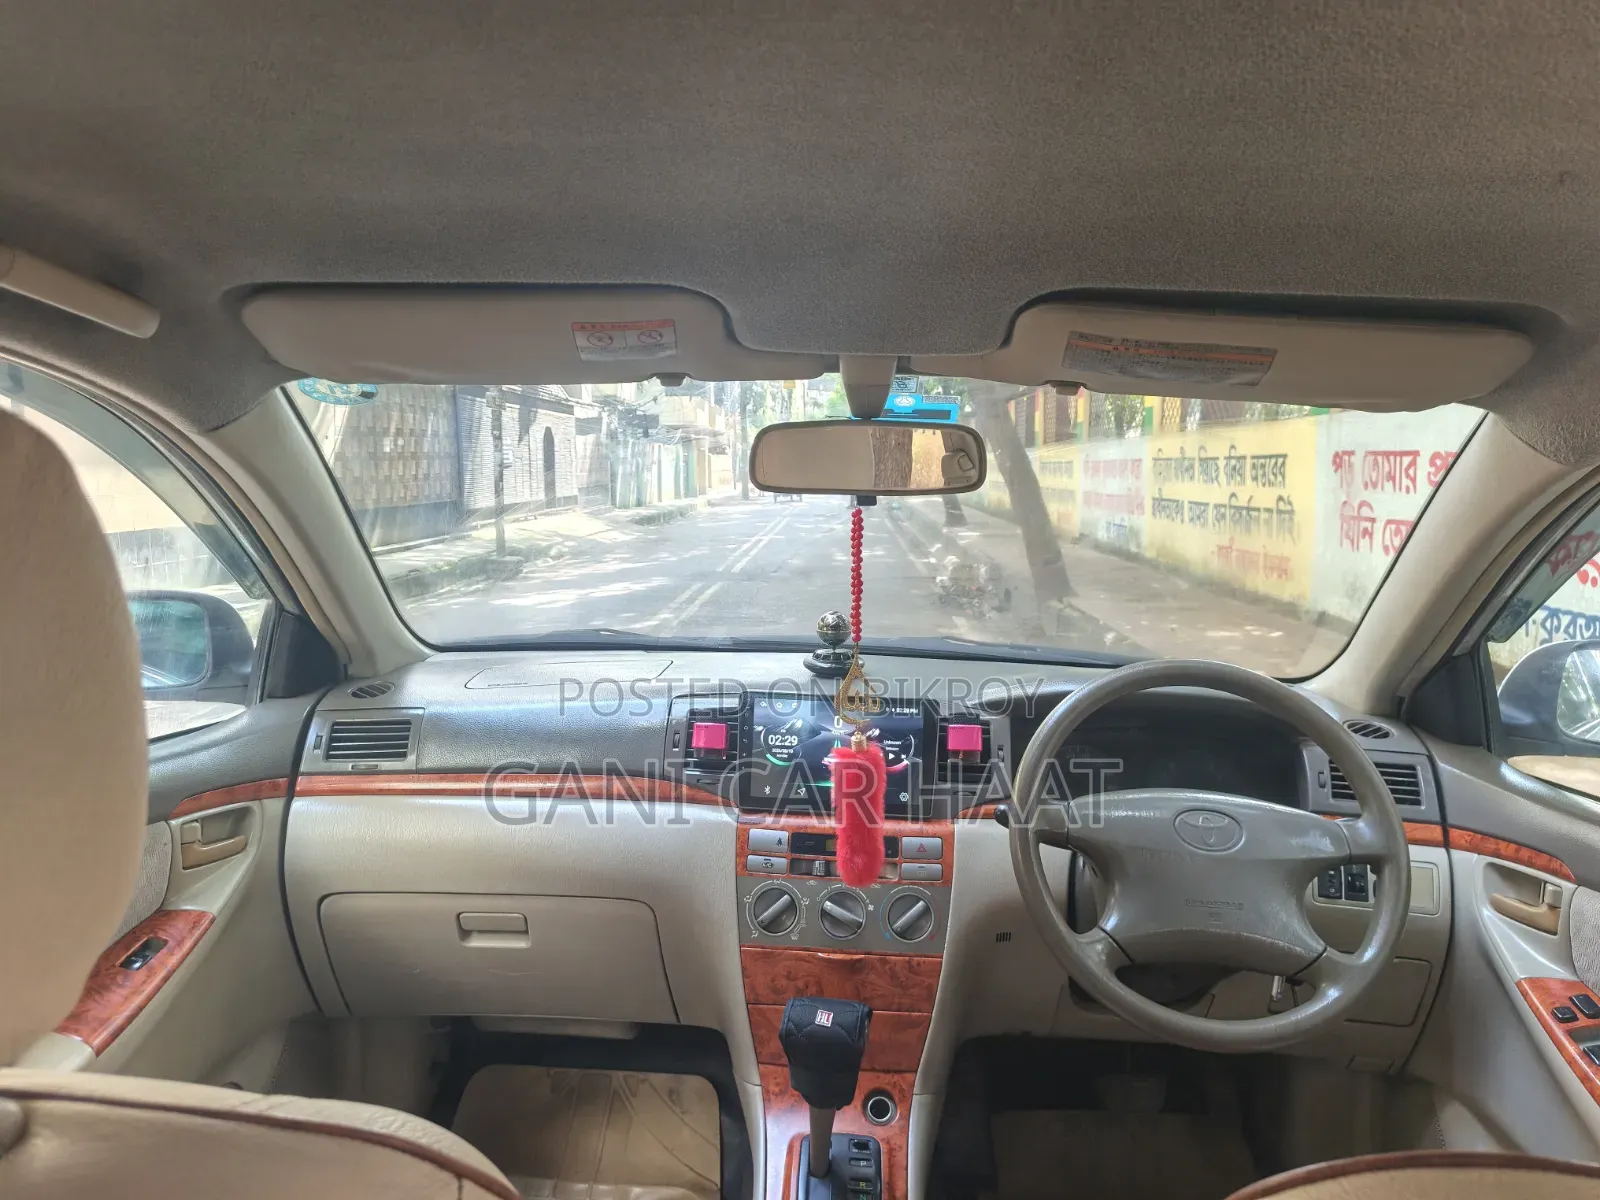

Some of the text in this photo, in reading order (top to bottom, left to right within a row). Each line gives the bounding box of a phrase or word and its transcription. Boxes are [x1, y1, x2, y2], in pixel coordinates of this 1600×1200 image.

[1362, 450, 1420, 495] তোমার
[1340, 500, 1376, 553] যিনি
[834, 716, 842, 728] 0
[768, 735, 799, 746] 02:29
